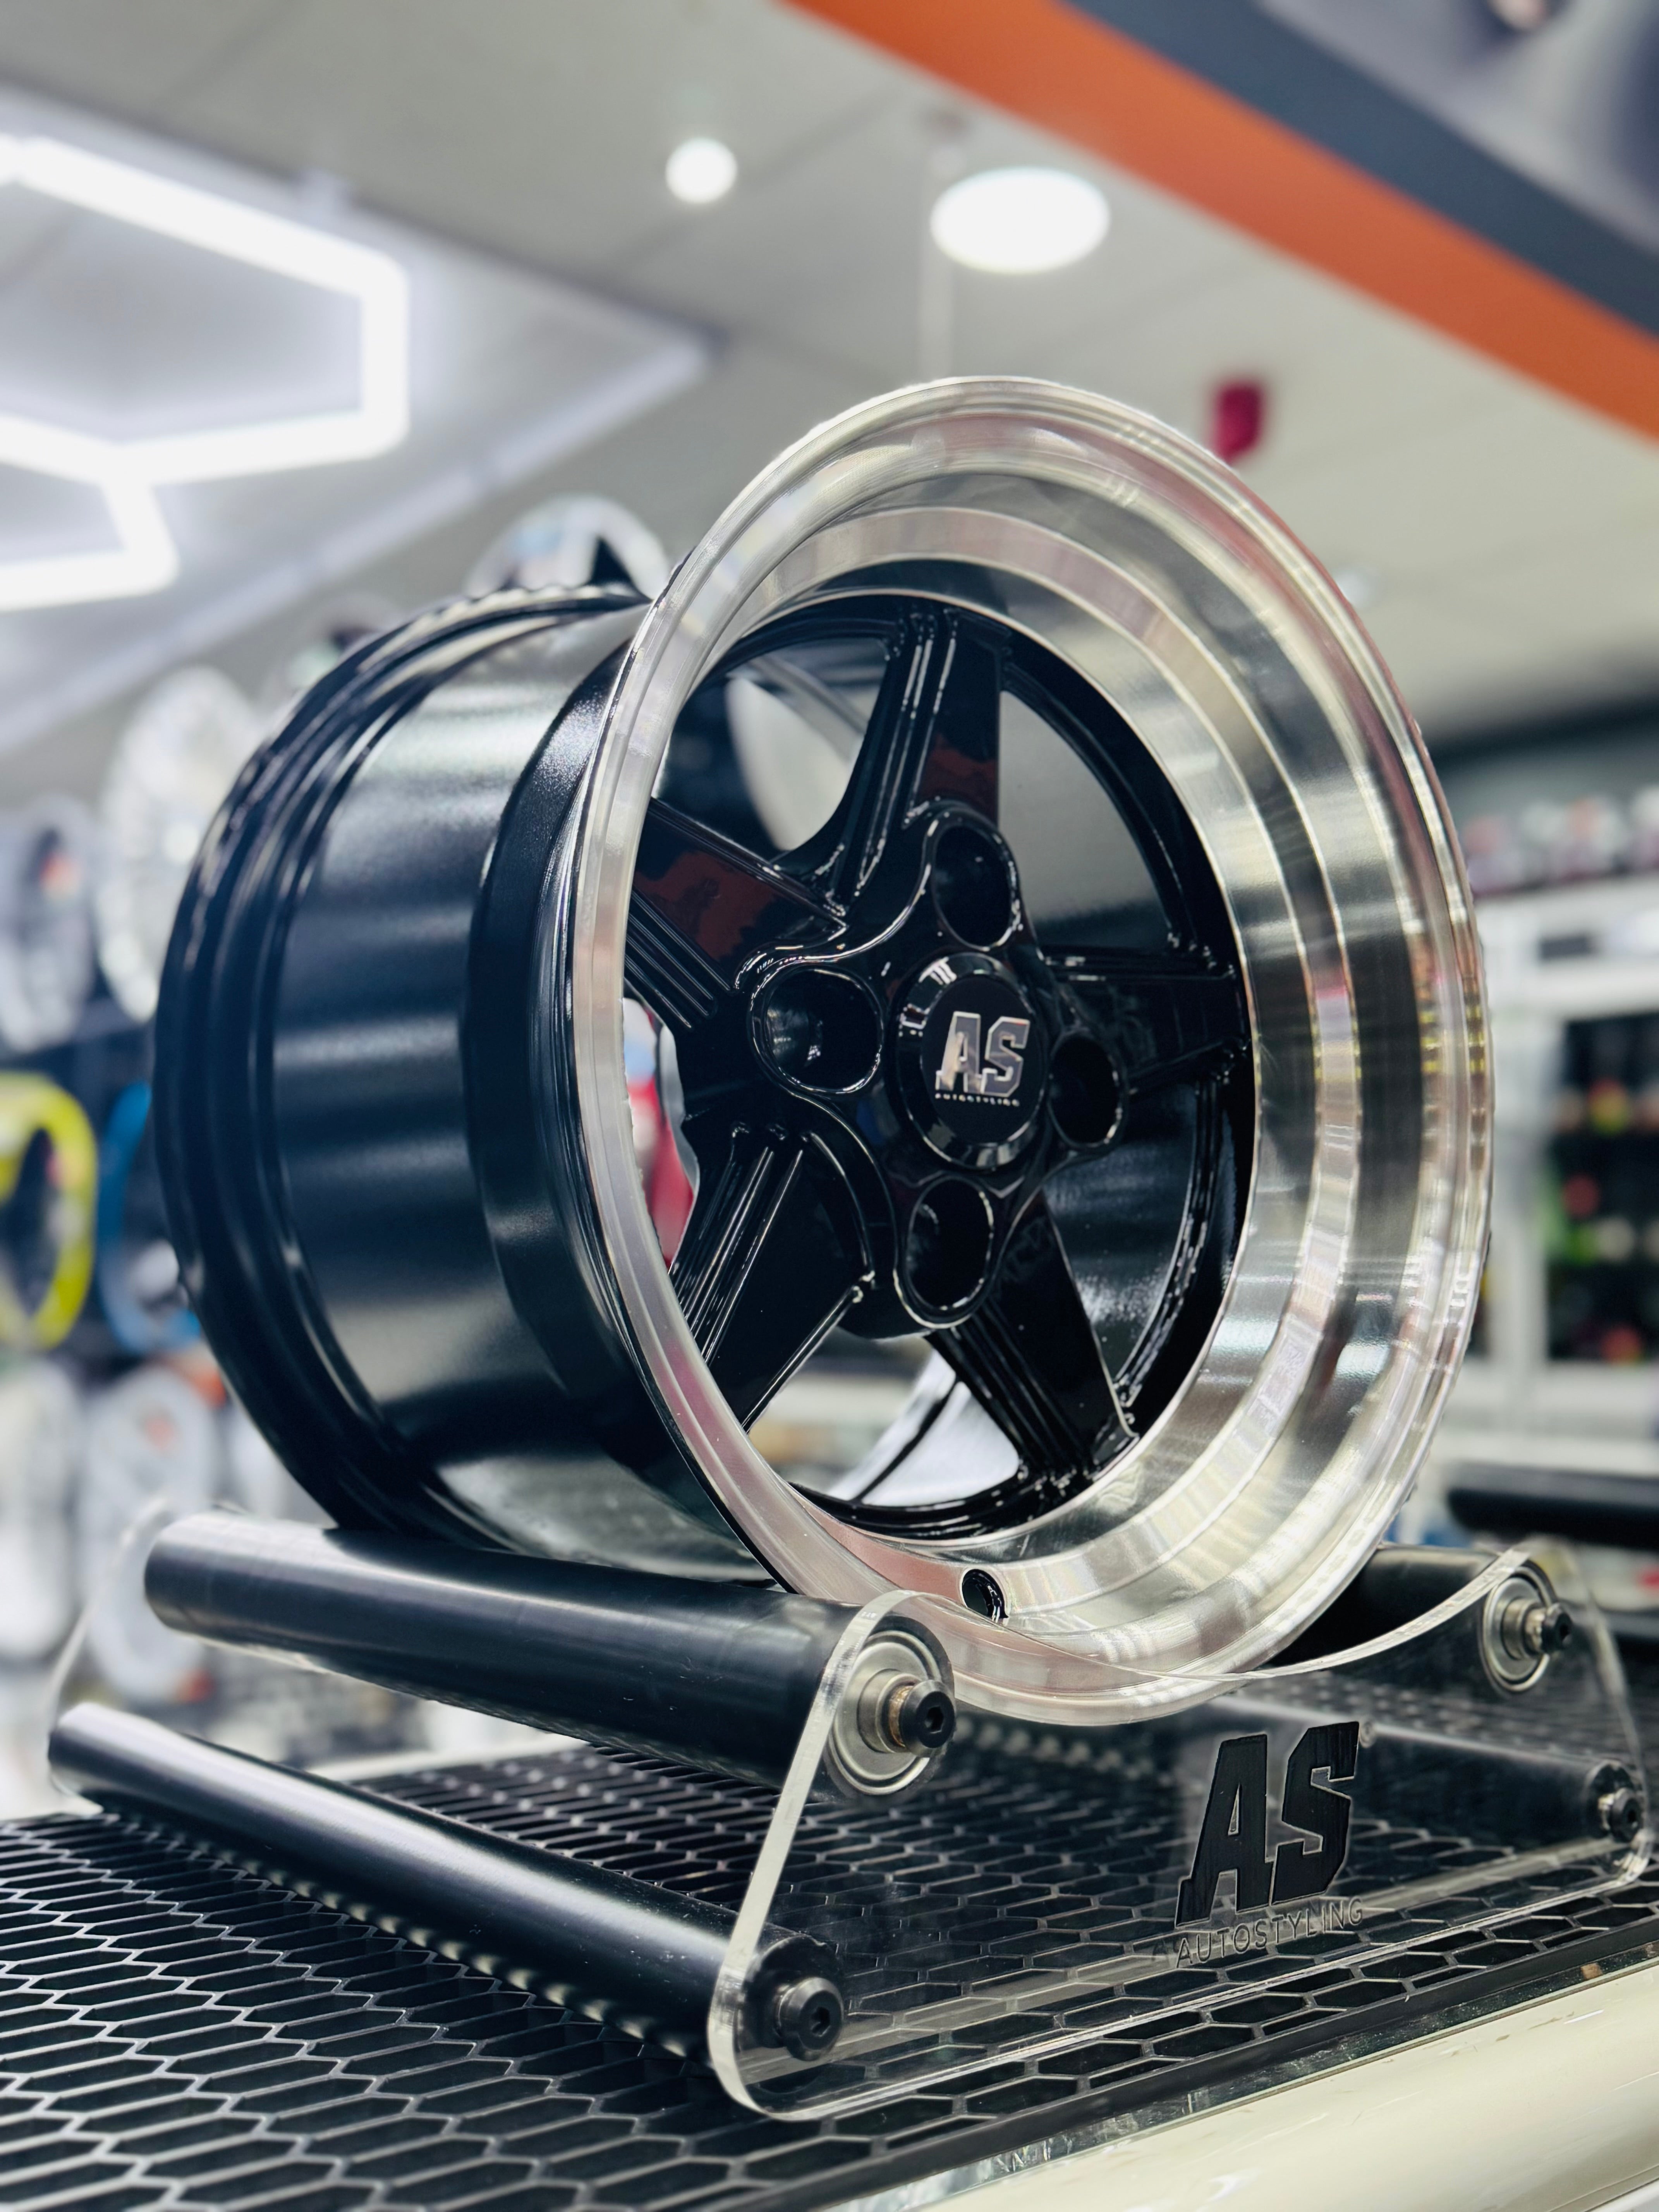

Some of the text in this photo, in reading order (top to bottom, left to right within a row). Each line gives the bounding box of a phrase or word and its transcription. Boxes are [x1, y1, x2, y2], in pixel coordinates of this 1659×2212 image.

[935, 1011, 1030, 1097] AS
[1175, 1721, 1359, 1927] AS
[1176, 1898, 1363, 1968] AUTOSTYLING
